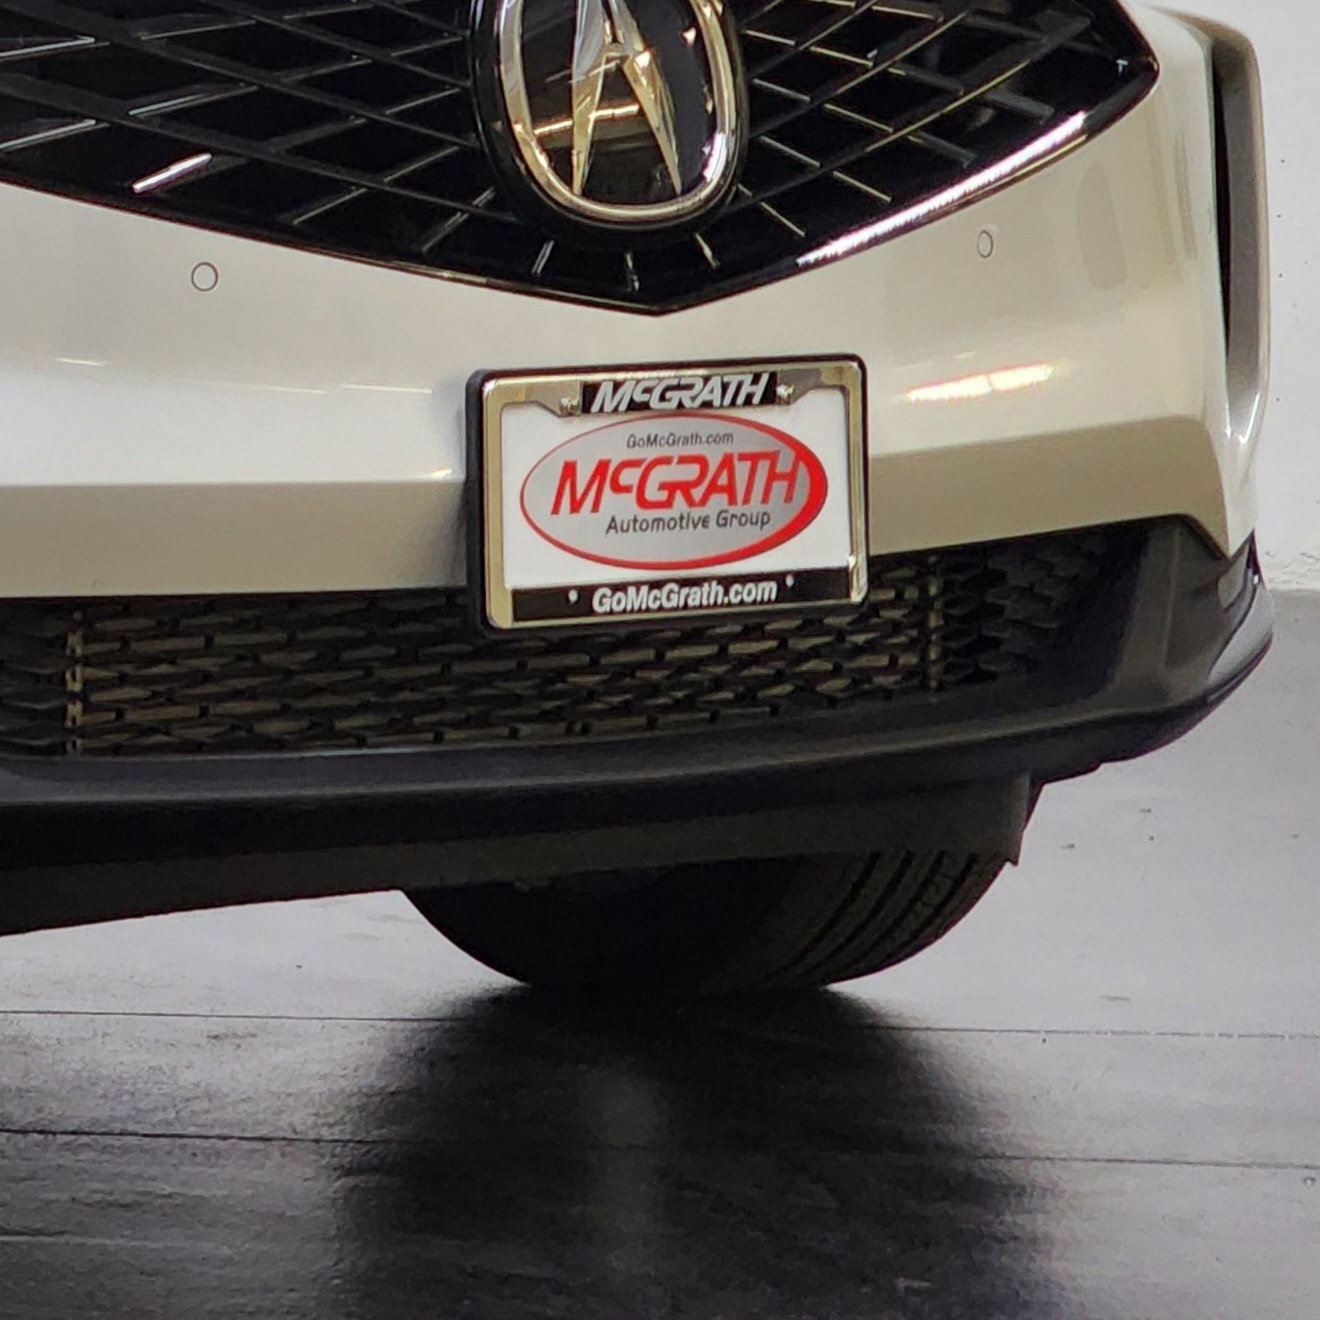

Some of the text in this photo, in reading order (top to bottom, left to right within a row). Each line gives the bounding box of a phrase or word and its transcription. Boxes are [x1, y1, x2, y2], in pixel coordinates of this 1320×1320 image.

[626, 432, 734, 450] GoMcGrath.com
[605, 509, 772, 535] Automotive Group
[591, 579, 778, 613] GoMcGrath.com
